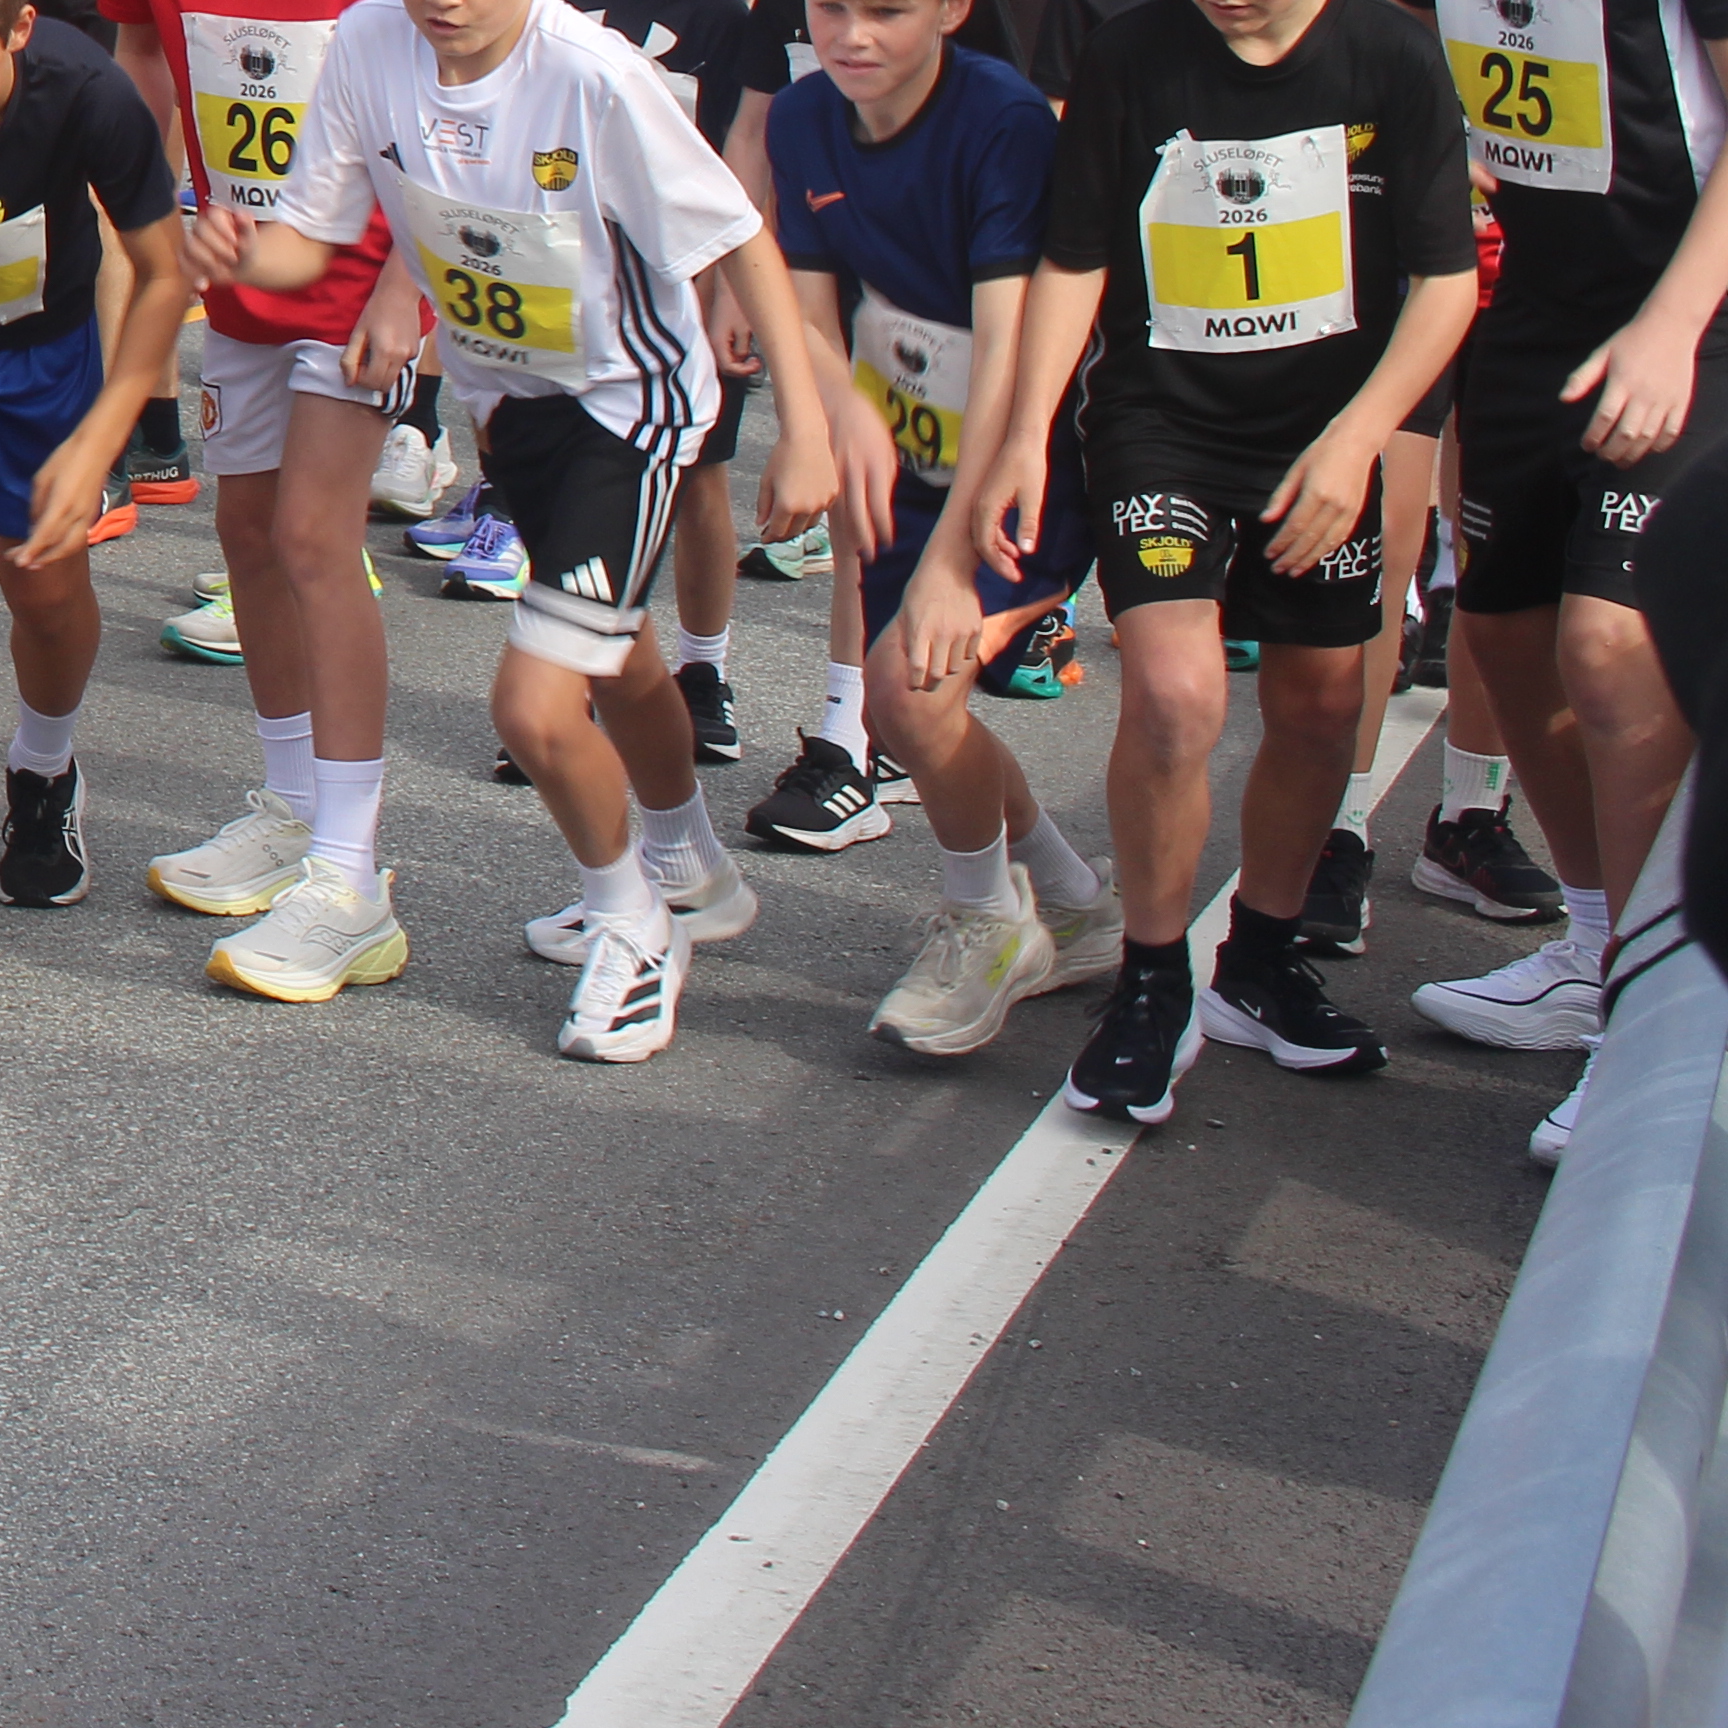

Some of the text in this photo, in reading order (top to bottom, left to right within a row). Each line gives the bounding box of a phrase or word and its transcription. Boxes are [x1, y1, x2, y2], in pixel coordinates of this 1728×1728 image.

[222, 25, 292, 51] SLUSELØPET
[1497, 30, 1535, 52] 2026
[239, 83, 278, 99] 2026
[1478, 51, 1554, 138] 25
[225, 102, 299, 176] 26
[420, 117, 490, 150] VEST
[1191, 144, 1284, 173] SLUSELØPET
[1217, 207, 1269, 225] 2026
[459, 254, 503, 276] 2026
[1225, 231, 1261, 302] 1
[443, 268, 527, 340] 38
[886, 387, 943, 467] 29
[1112, 493, 1164, 523] PAY
[1601, 491, 1662, 514] PAY
[1112, 510, 1166, 536] TEC
[1139, 536, 1192, 549] SKJOLD
[1320, 555, 1368, 581] TEC
